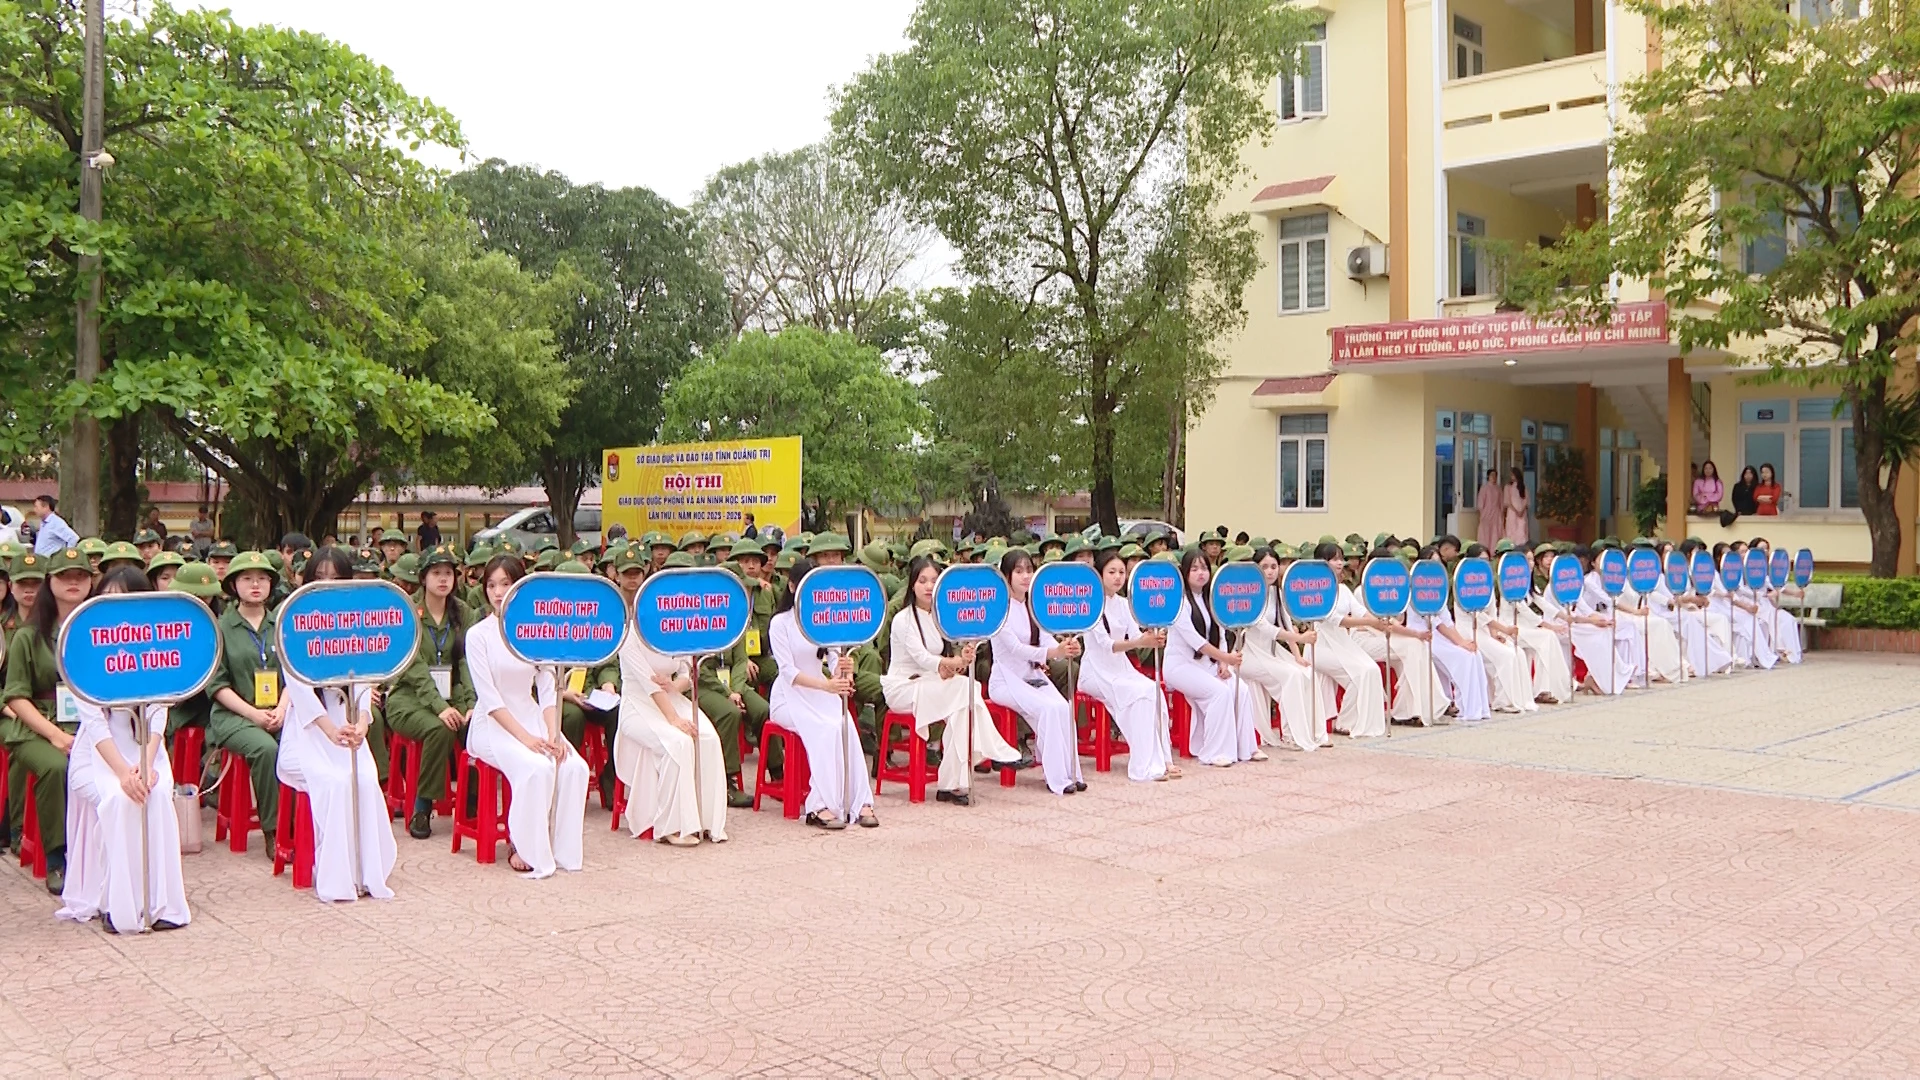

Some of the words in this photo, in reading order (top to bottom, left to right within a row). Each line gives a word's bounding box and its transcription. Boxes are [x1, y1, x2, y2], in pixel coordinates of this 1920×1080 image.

[1345, 330, 1382, 344] TRƯỜNG
[1385, 329, 1408, 341] THPT
[1462, 321, 1484, 334] TIẾP
[1488, 321, 1509, 335] TỤC
[1630, 310, 1653, 324] TẬP
[1339, 346, 1351, 359] VÀ
[1353, 344, 1375, 358] LÀM
[1377, 344, 1401, 357] THEO
[1404, 342, 1417, 354] TƯ
[1458, 338, 1479, 352] ĐẠO
[1510, 334, 1548, 347] PHONG
[1551, 331, 1582, 344] CÁCH
[1604, 327, 1624, 340] CHÍ
[1628, 325, 1661, 339] MINH
[664, 473, 691, 492] HỘI
[694, 474, 723, 489] THI
[696, 495, 706, 504] AN
[707, 495, 724, 504] NINH
[725, 495, 739, 506] HỌC
[740, 495, 758, 504] SINH
[759, 495, 777, 504] THPT
[1043, 581, 1074, 598] TRƯỜNG
[1075, 584, 1093, 598] THPT
[1138, 574, 1161, 590] TRƯỜNG
[1161, 576, 1175, 590] THPT
[656, 591, 701, 611] TRƯỜNG
[703, 593, 730, 609] THPT
[812, 586, 847, 605] TRƯỜNG
[849, 587, 870, 603] THPT
[947, 586, 977, 604] TRƯỜNG
[978, 586, 997, 602] THPT
[534, 597, 573, 616] TRƯỜNG
[575, 600, 599, 617] THPT
[812, 606, 831, 625] CHẾ
[832, 609, 849, 624] LAN
[851, 605, 871, 623] VIÊN
[957, 607, 975, 623] CAM
[293, 609, 335, 631] TRƯỜNG
[337, 611, 362, 629] THPT
[364, 606, 403, 627] CHUYÊN
[660, 617, 684, 633] CHU
[686, 613, 709, 632] VĂN
[711, 615, 727, 631] AN
[90, 621, 152, 646] TRƯỜNG
[155, 621, 192, 641] THPT
[516, 621, 556, 640] CHUYÊN
[557, 621, 571, 640] LÊ
[571, 621, 591, 642] QUÝ
[592, 621, 614, 641] ĐÔN
[308, 635, 322, 657] VÕ
[323, 634, 365, 655] NGUYÊN
[366, 631, 391, 653] GIÁP
[105, 648, 138, 673] CỬA
[140, 647, 181, 670] TÙNG
